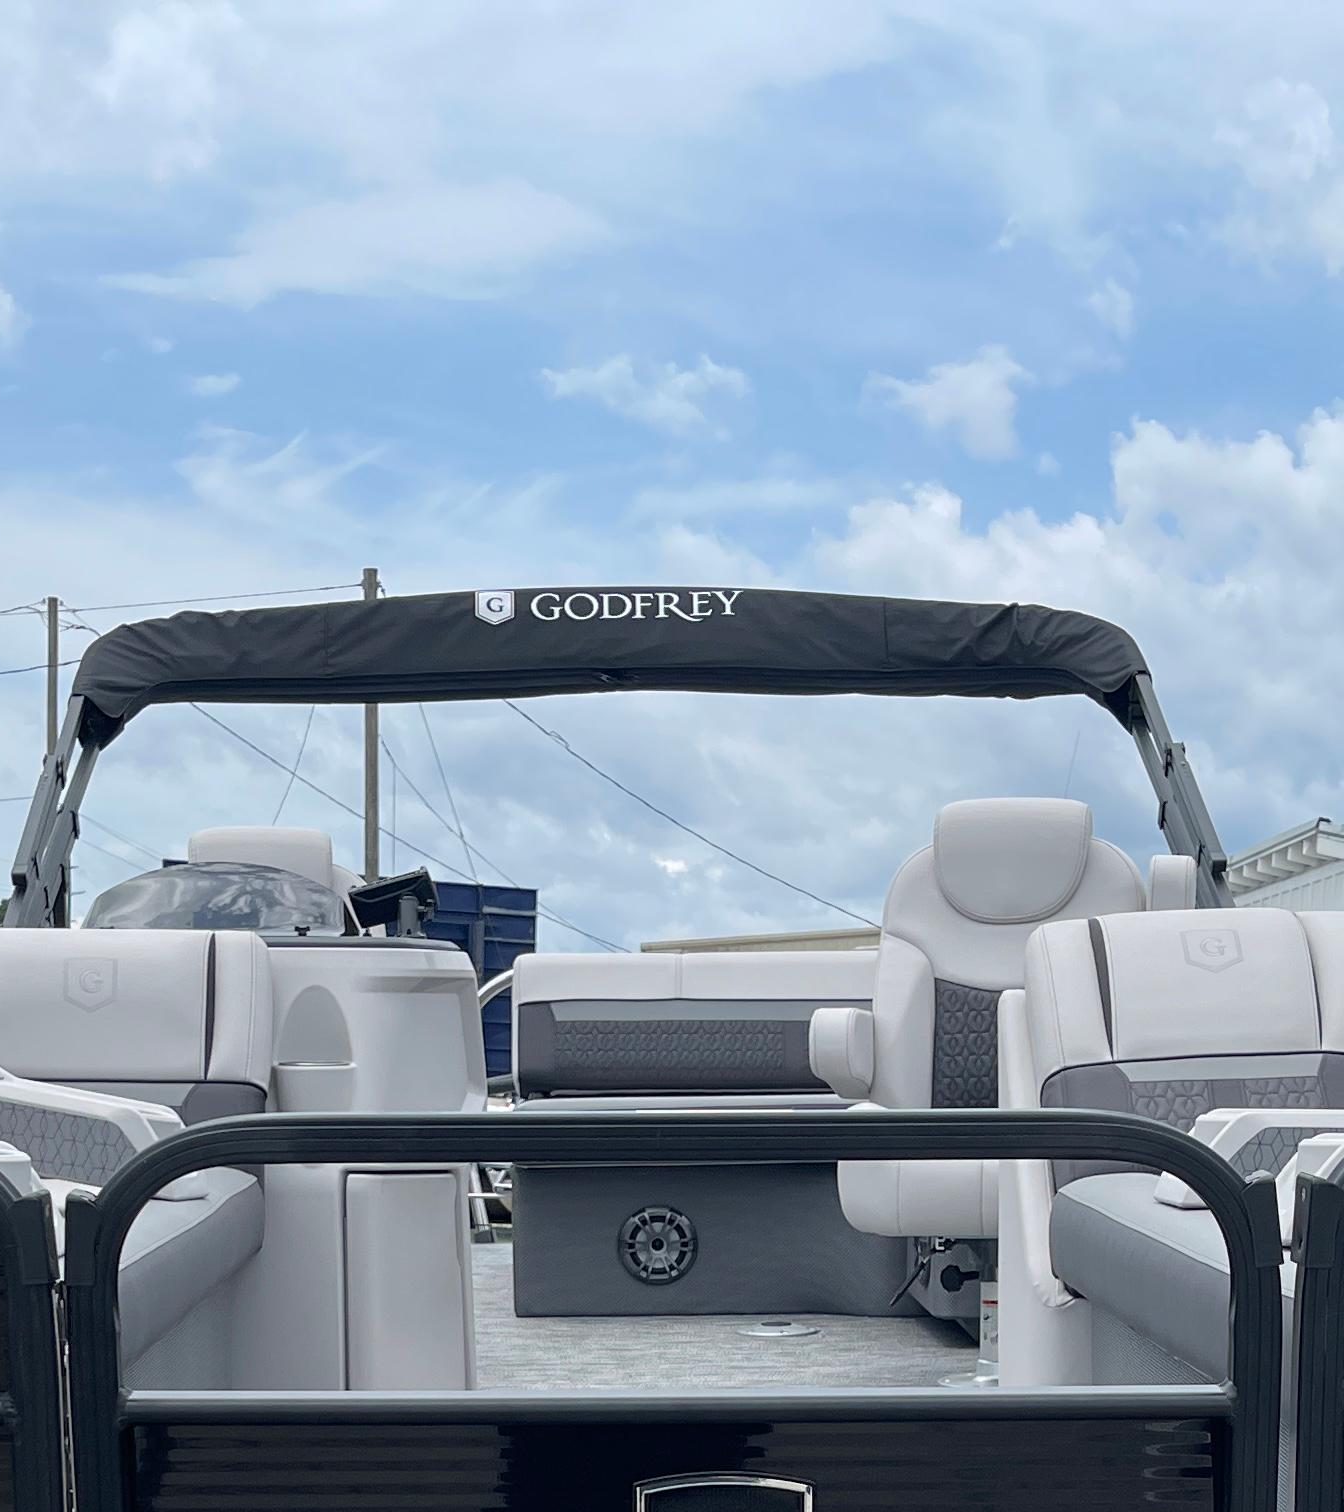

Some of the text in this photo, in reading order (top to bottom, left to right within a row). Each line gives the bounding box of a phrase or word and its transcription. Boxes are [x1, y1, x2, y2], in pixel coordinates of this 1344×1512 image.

[486, 590, 744, 622] G GODFREY
[1199, 937, 1226, 957] G
[80, 969, 103, 993] G
